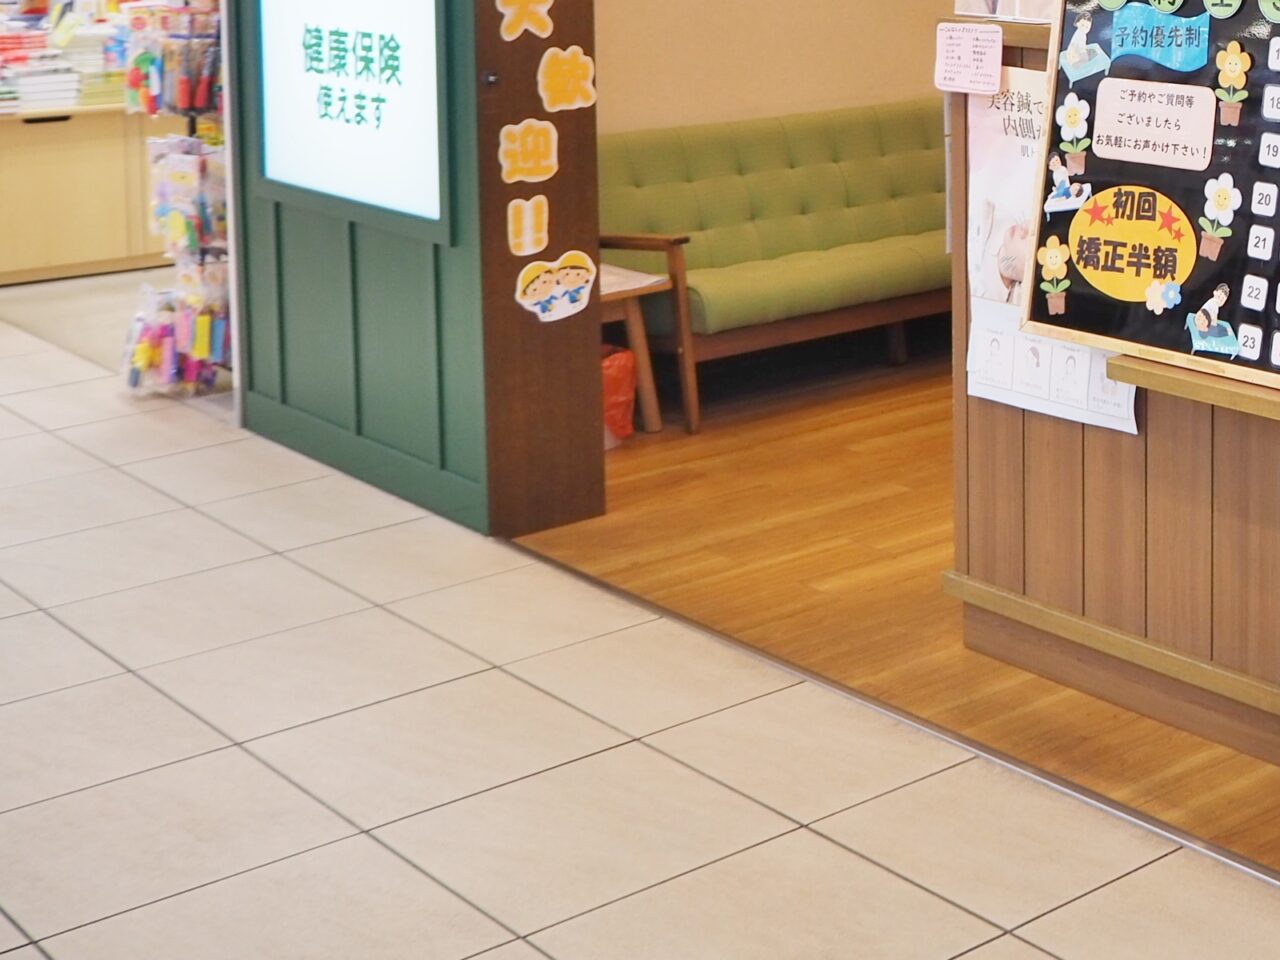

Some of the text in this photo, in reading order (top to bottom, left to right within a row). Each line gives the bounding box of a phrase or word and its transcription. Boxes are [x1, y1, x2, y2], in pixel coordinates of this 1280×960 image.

[1115, 25, 1202, 49] 予約優先制
[302, 23, 402, 86] 健康保険
[317, 84, 387, 130] 使えます
[1119, 89, 1195, 109] ご予約やご質問等
[1116, 112, 1182, 131] ございましたら
[1096, 134, 1208, 159] お気軽にお声かけ下さい!
[1265, 143, 1279, 157] 19
[1112, 187, 1158, 222] 初回
[1257, 192, 1272, 207] 20
[1253, 236, 1267, 250] 21
[1076, 235, 1178, 282] 矯正半額
[1246, 285, 1261, 300] 22
[1242, 334, 1256, 349] 23
